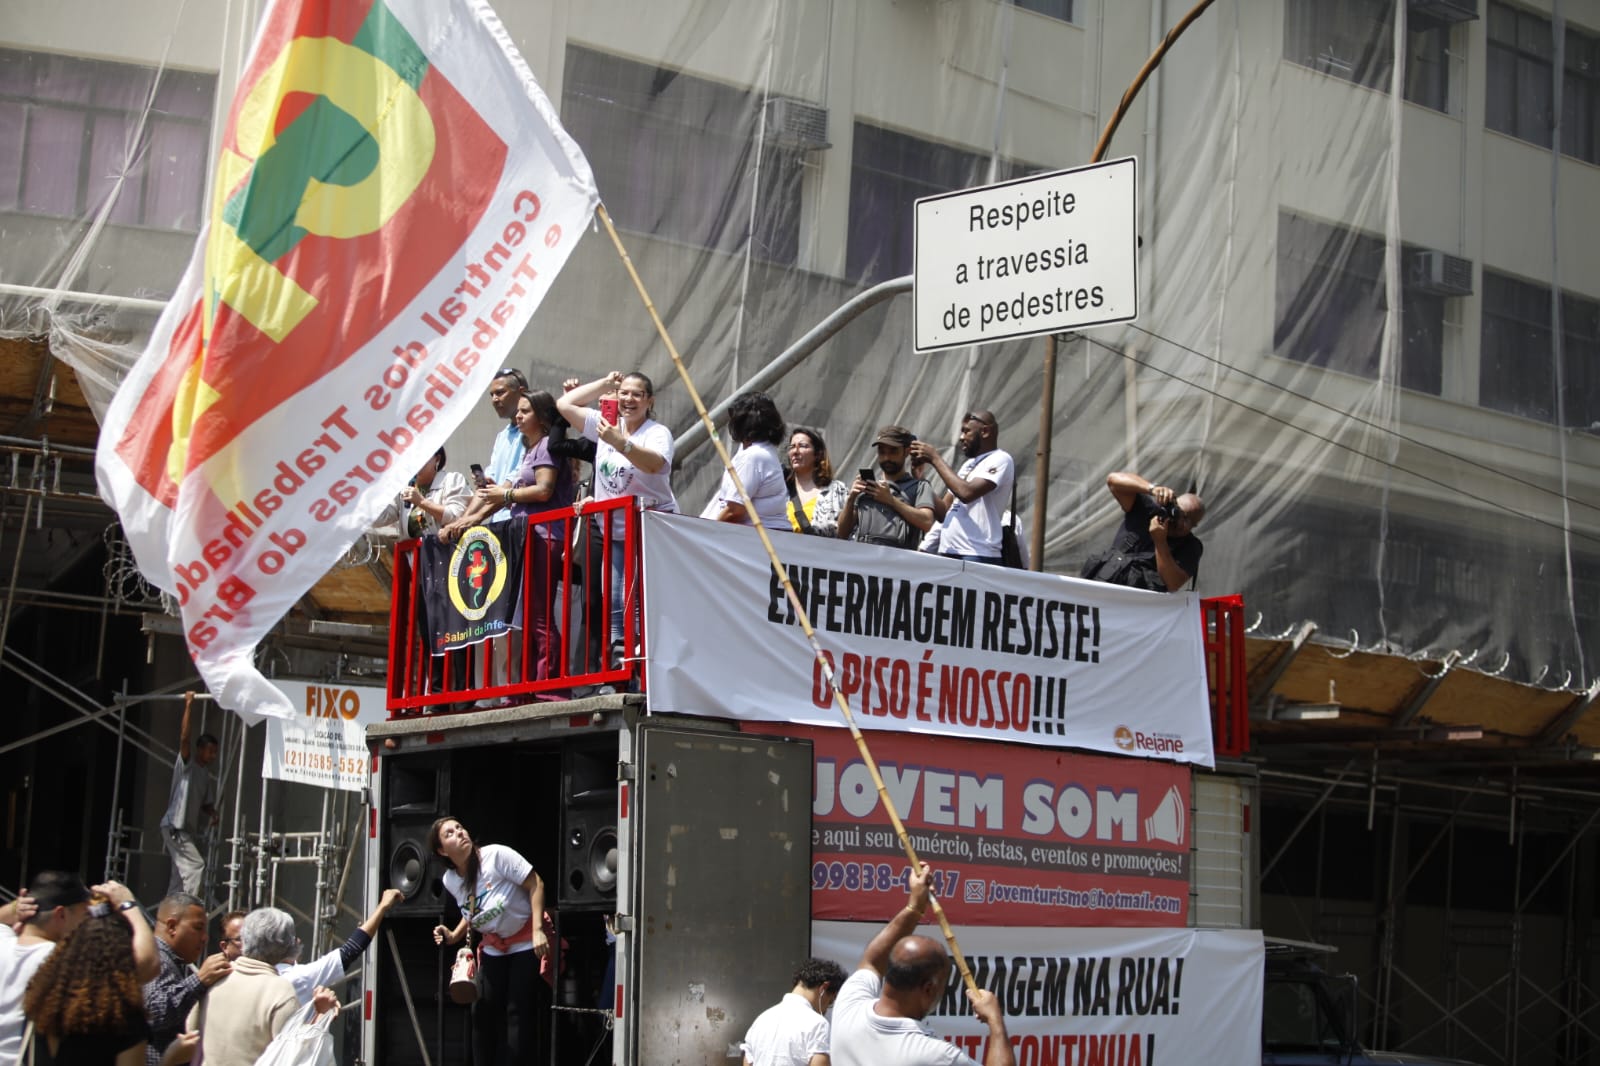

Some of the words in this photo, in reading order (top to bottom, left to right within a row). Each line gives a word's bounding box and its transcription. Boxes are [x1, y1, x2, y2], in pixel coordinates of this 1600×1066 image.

[969, 190, 1076, 232] Respeite
[955, 262, 969, 285] a
[977, 238, 1089, 281] travessia
[942, 303, 971, 331] de
[980, 285, 1105, 332] pedestres
[768, 561, 977, 648] ENFERMAGEM
[981, 591, 1100, 664] RESISTE!
[305, 686, 361, 720] FIXO
[812, 648, 835, 710] O
[841, 652, 911, 719] PISO
[916, 649, 934, 722] É
[938, 663, 1067, 736] NOSSO!!!
[1135, 732, 1184, 754] Rejane
[813, 757, 1004, 830] JOVEM
[1021, 777, 1140, 843] SOM
[824, 826, 860, 852] aqui
[865, 831, 894, 848] seu
[976, 836, 1028, 865] festas,
[1031, 846, 1088, 867] eventos
[1091, 853, 1101, 867] e
[1104, 852, 1183, 876] promoções!
[812, 861, 960, 898] 99838-447
[988, 879, 1182, 914] jovemturismo@hotmail.com
[928, 956, 1071, 1017] RMAGEM
[1072, 957, 1111, 1016] NA
[1115, 957, 1185, 1016] RUA!
